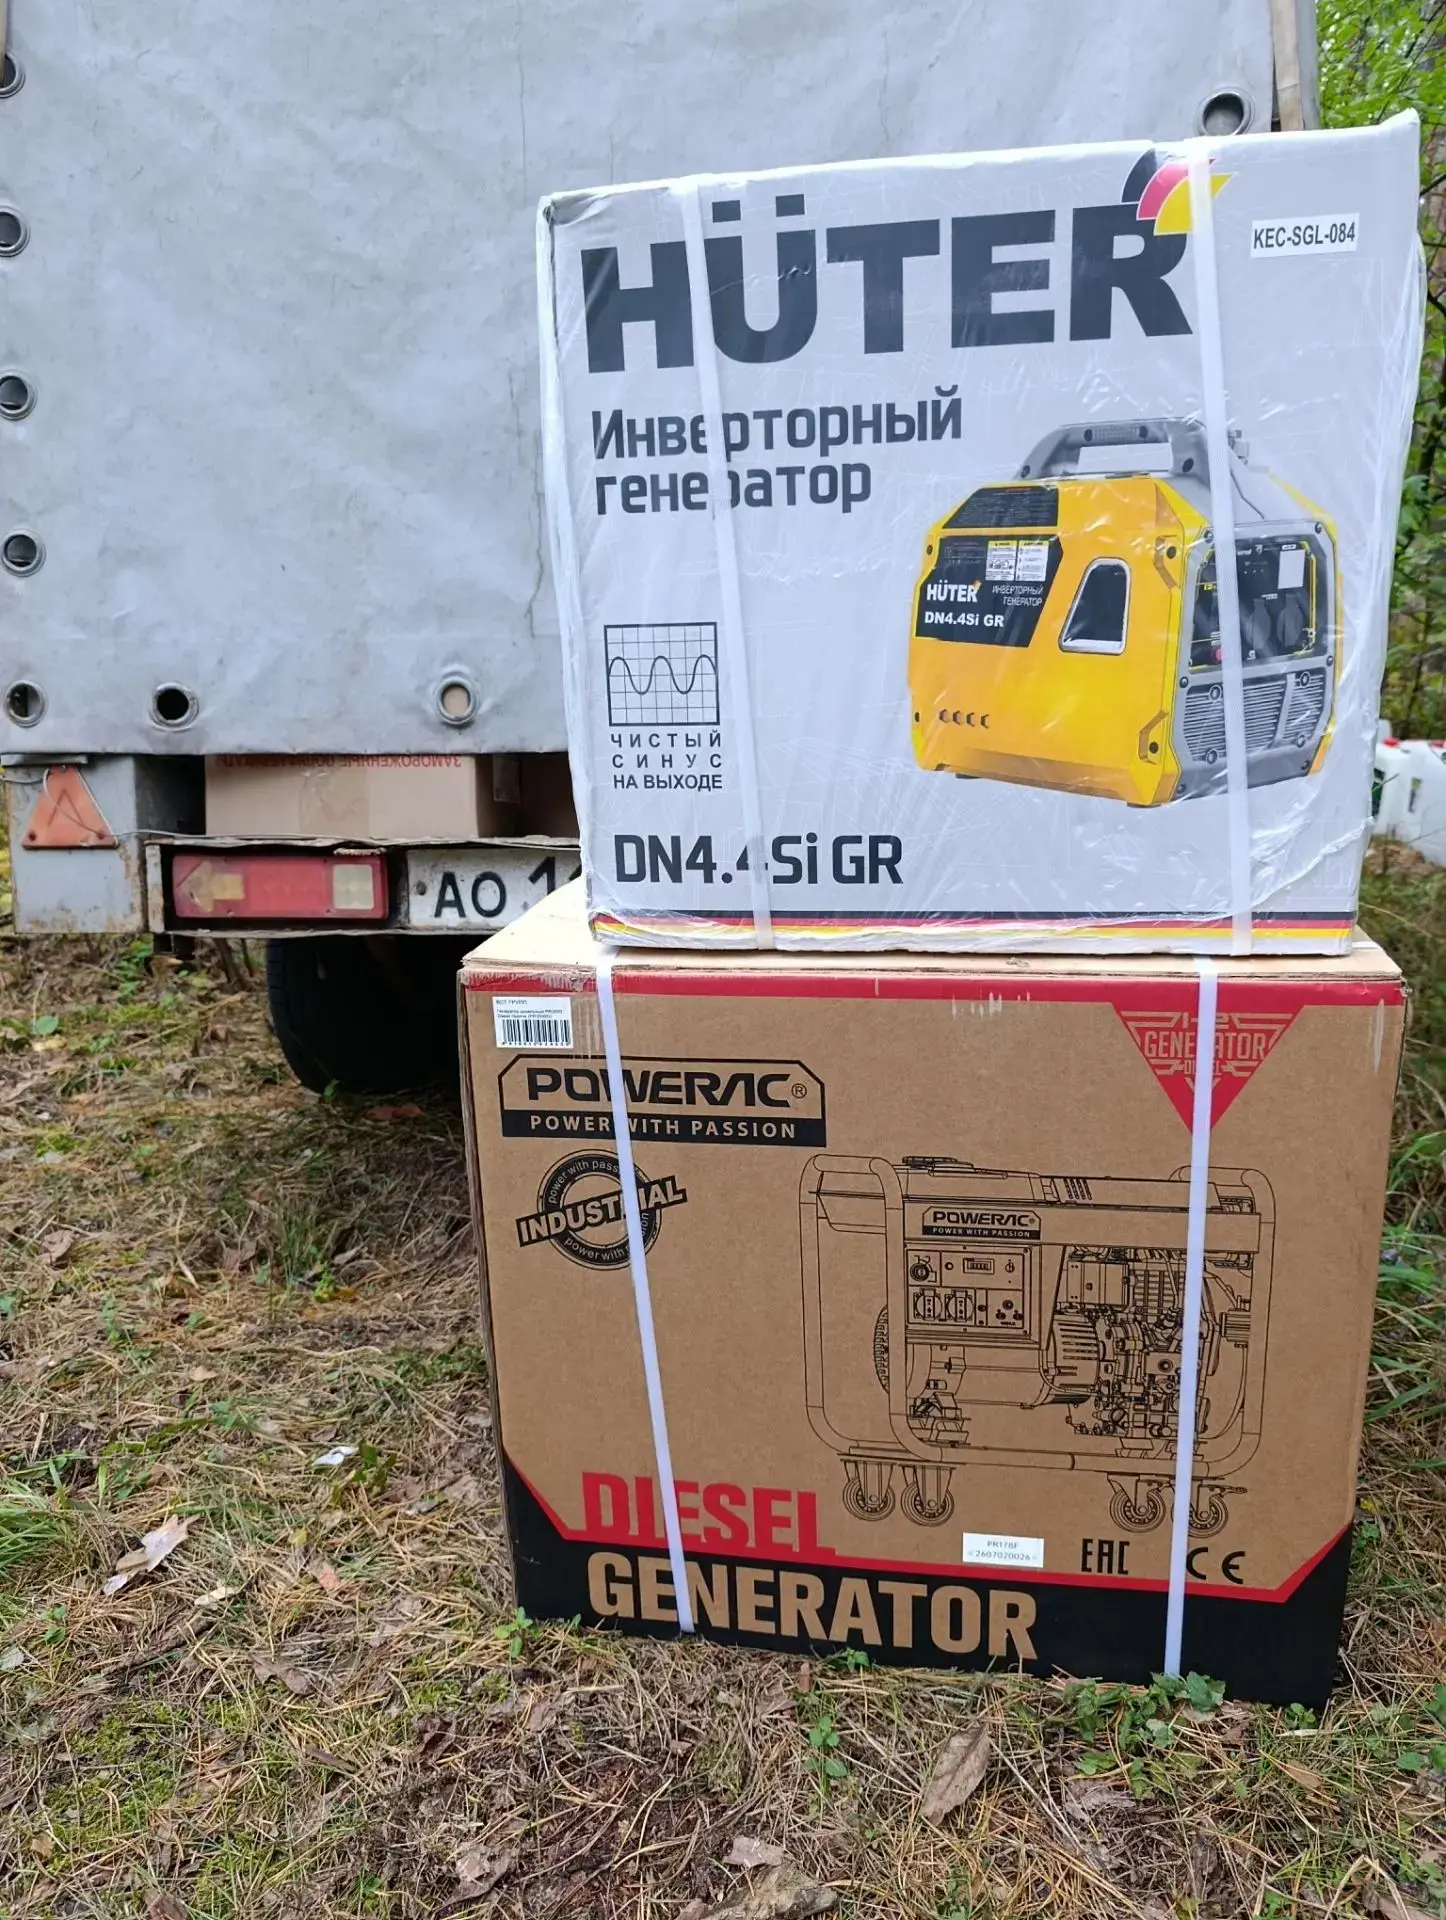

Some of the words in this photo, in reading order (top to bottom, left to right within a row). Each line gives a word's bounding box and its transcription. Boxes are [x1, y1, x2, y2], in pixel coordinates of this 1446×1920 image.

[1253, 221, 1356, 249] KEC-SGL-084
[581, 194, 1193, 373] HÜTER
[592, 384, 962, 462] Инверторный
[926, 579, 978, 603] HÜTER
[1003, 596, 1043, 607] ГЕНЕРАТОР
[924, 611, 980, 626] DN4.4Si
[983, 614, 1005, 627] GR
[610, 729, 722, 749] ЧИСТЫЙ
[612, 753, 722, 769] СИНУС
[613, 774, 638, 790] НА
[643, 774, 723, 792] ВЫХОДЕ
[832, 835, 904, 884] GR
[528, 856, 582, 896] 1
[1144, 1031, 1266, 1060] GENEATOR
[530, 1114, 611, 1133] POWER
[692, 1120, 796, 1139] PASSION
[548, 1171, 569, 1204] power
[567, 1159, 590, 1175] with
[519, 1180, 683, 1242] INDUSTIAL
[932, 1227, 964, 1236] POWER
[966, 1228, 989, 1237] WITH
[992, 1229, 1030, 1238] PASSION
[563, 1237, 601, 1260] power
[601, 1248, 625, 1261] with
[582, 1472, 836, 1555] DIESEL
[587, 1552, 1038, 1660] GENERATOR
